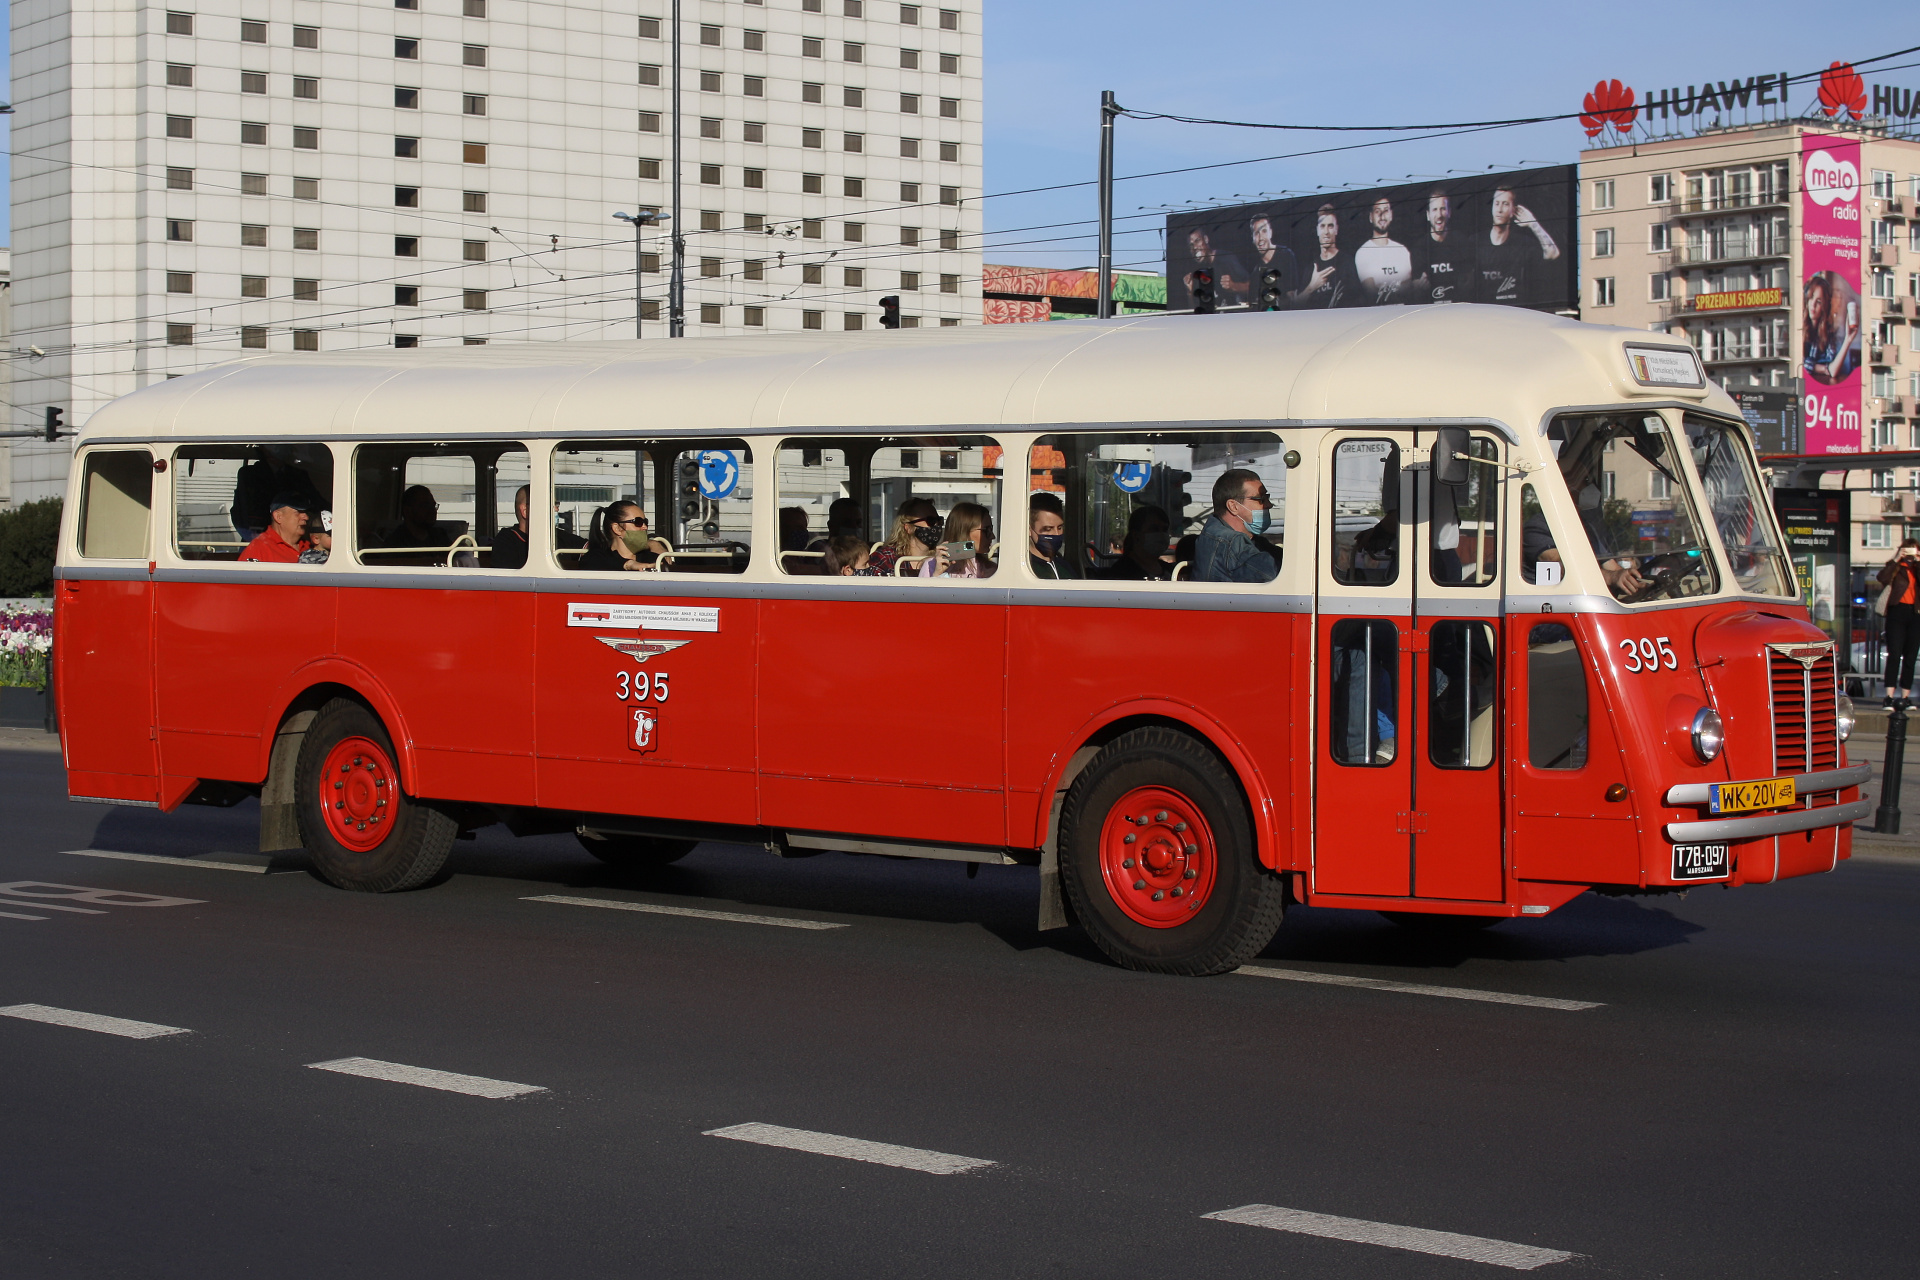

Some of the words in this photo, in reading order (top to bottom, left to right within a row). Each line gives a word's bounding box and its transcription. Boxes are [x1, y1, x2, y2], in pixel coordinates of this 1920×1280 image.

[1646, 72, 1787, 121] HUAWEI
[1812, 168, 1853, 190] melo
[1833, 204, 1858, 221] radio
[1804, 232, 1859, 247] najprzyjemniejsza
[1834, 249, 1859, 260] muzyka
[1382, 266, 1399, 276] TCL
[1431, 263, 1454, 274] TCL
[1695, 293, 1737, 310] SPRZEDAM
[1804, 394, 1833, 429] 94
[1836, 403, 1859, 430] fm
[1341, 443, 1386, 453] GREATNESS
[1546, 567, 1551, 581] 1
[617, 643, 665, 651] CHAUSSON
[1619, 636, 1678, 673] 395
[615, 671, 669, 702] 395
[1712, 801, 1719, 809] PL
[1722, 785, 1747, 809] WK
[1753, 782, 1777, 807] 20V
[1676, 845, 1725, 868] T78-097
